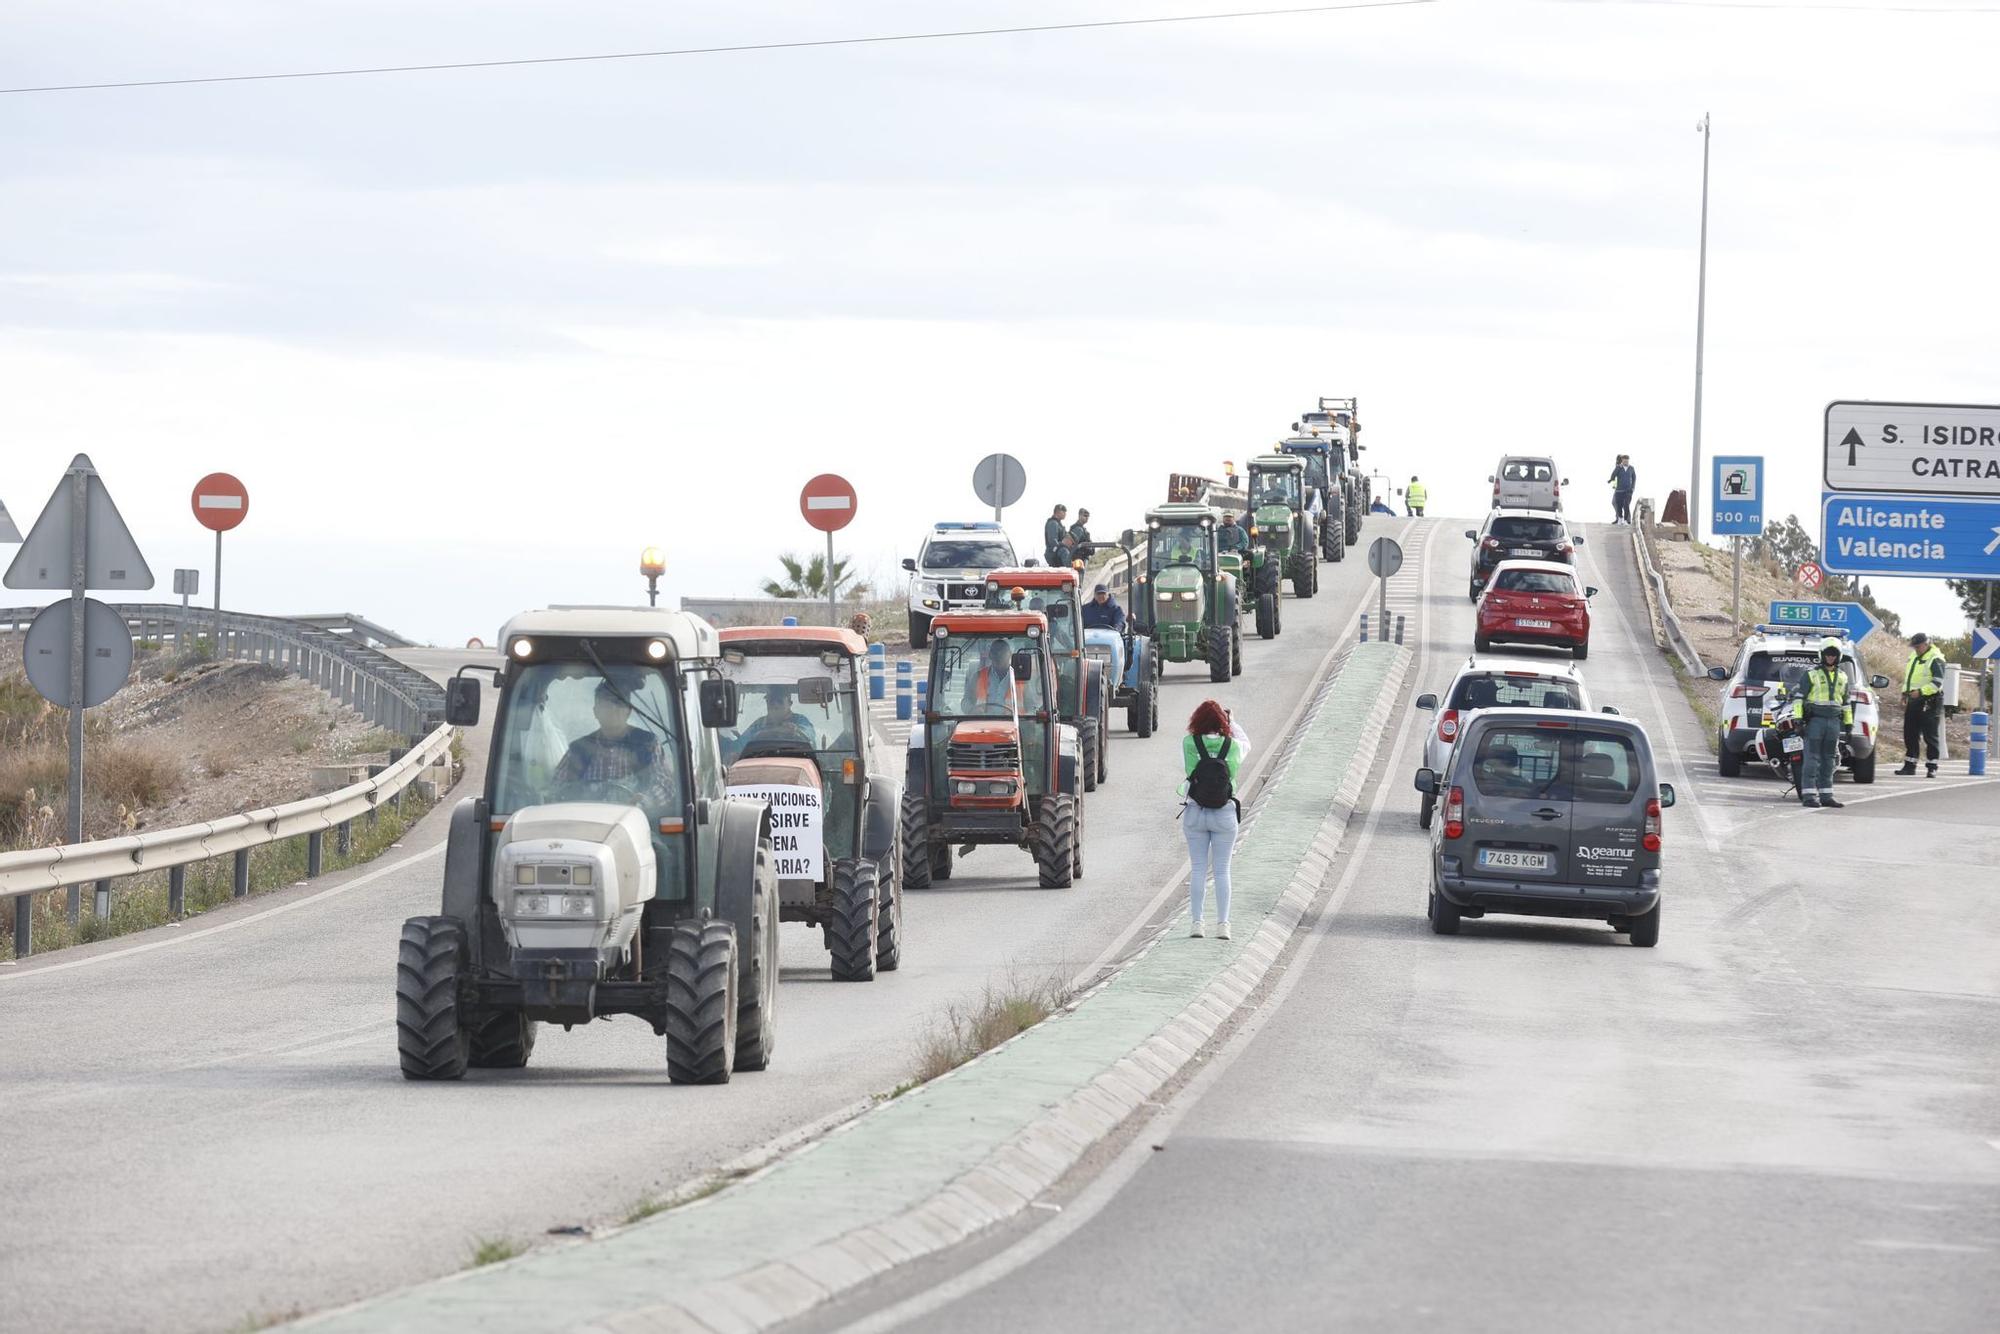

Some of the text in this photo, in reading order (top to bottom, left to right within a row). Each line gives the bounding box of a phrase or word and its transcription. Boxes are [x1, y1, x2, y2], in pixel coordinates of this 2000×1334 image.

[1881, 424, 2000, 447] S. ISIDR
[1716, 512, 1760, 523] 500 m
[1837, 507, 1945, 529] Alicante
[1837, 537, 1945, 559] Valencia
[1779, 606, 1809, 619] E-15
[1820, 608, 1845, 620] A-7
[772, 813, 809, 828] SIRVE
[770, 836, 798, 851] ENA
[1488, 852, 1544, 867] 7483 KGM
[1591, 847, 1635, 859] geamur
